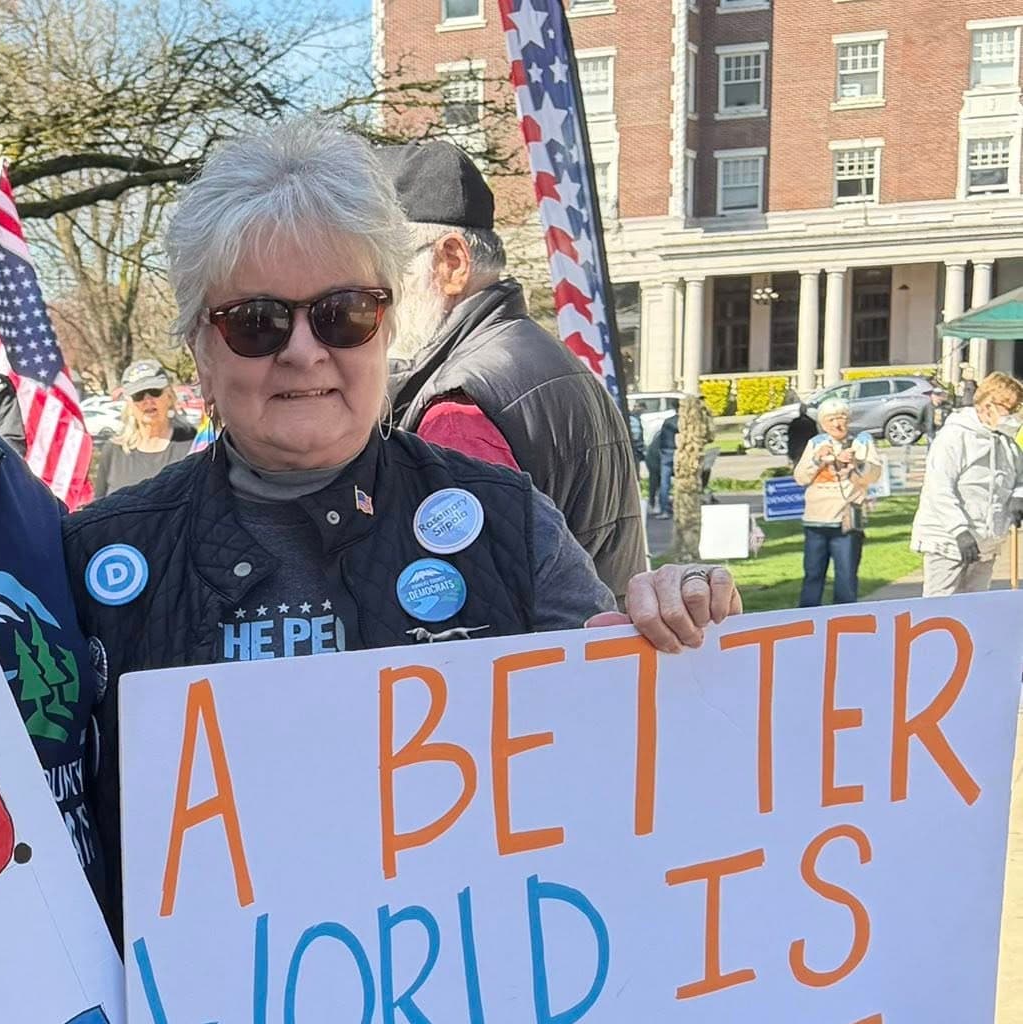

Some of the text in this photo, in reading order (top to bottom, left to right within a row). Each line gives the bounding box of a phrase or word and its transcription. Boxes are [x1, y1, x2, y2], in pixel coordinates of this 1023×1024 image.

[418, 496, 467, 533] Rosemary
[104, 562, 128, 586] D
[408, 579, 455, 601] DEMOCRATS
[218, 619, 275, 661] HE
[159, 611, 981, 917] A BETTER
[665, 822, 873, 1000] IS
